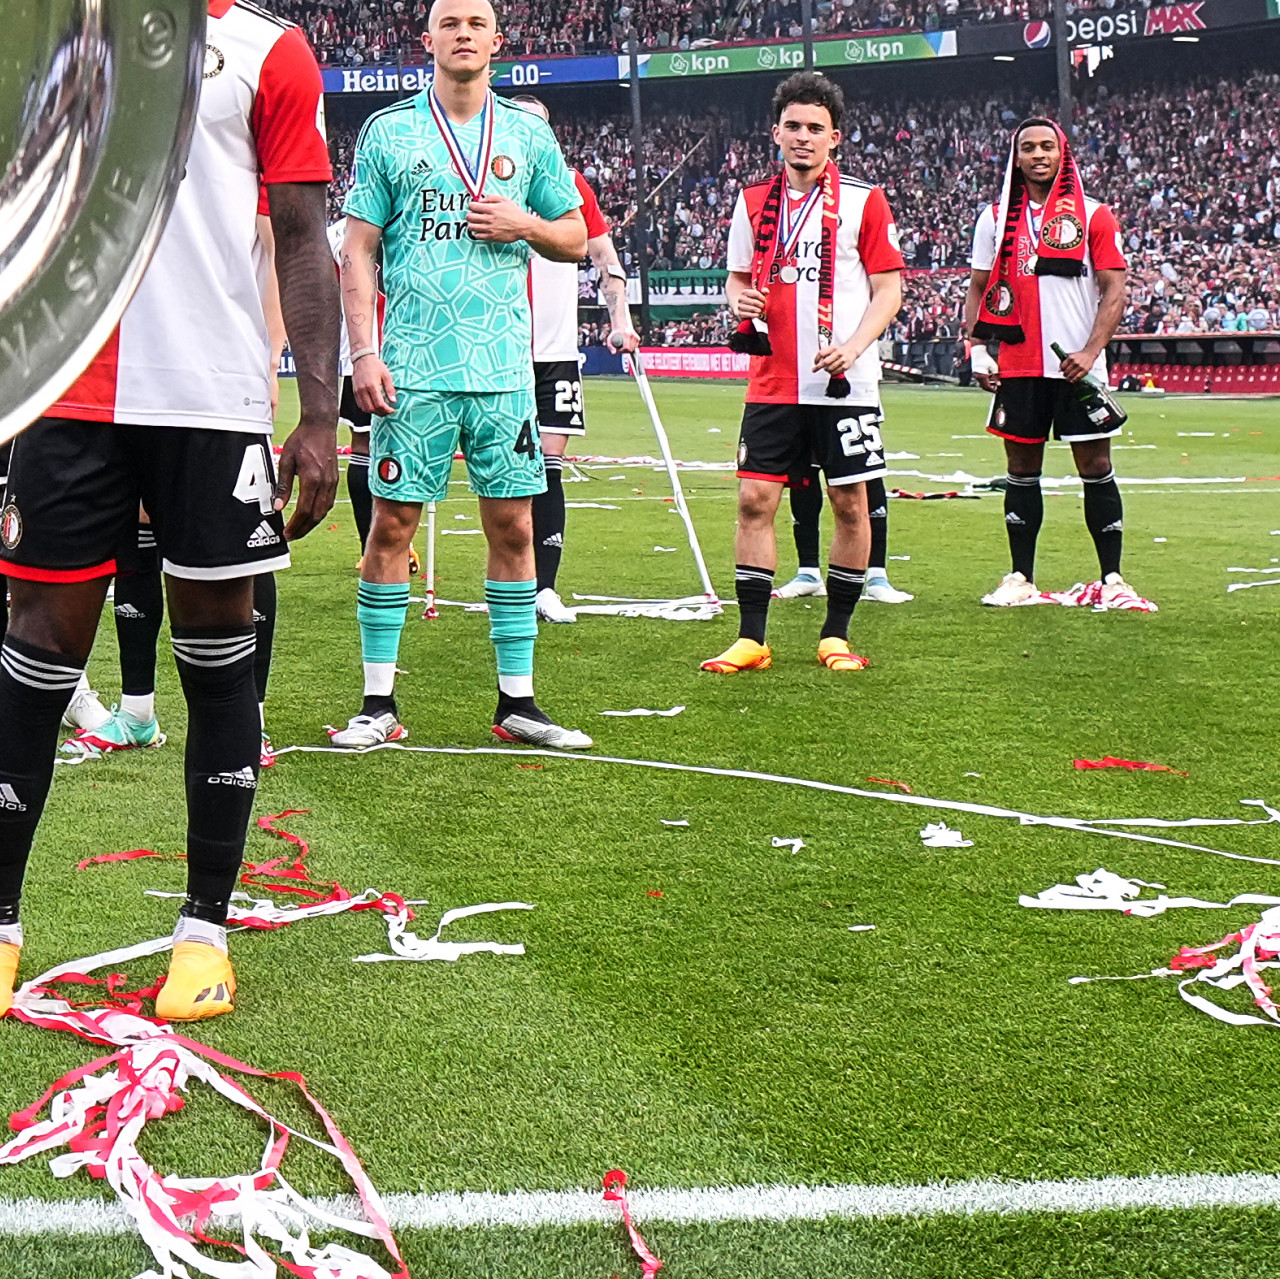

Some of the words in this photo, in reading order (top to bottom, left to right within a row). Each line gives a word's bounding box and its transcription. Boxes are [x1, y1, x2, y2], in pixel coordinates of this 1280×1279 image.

[1143, 1, 1207, 36] MAX
[866, 40, 904, 59] kpn
[691, 54, 729, 72] kpn
[342, 68, 434, 92] Heinek
[421, 188, 475, 214] Eur
[420, 217, 479, 241] Par
[769, 263, 821, 284] Prc
[555, 380, 583, 413] 23
[837, 413, 885, 457] 25
[232, 443, 275, 516] 4
[246, 536, 281, 548] adidas
[207, 775, 258, 789] adidas
